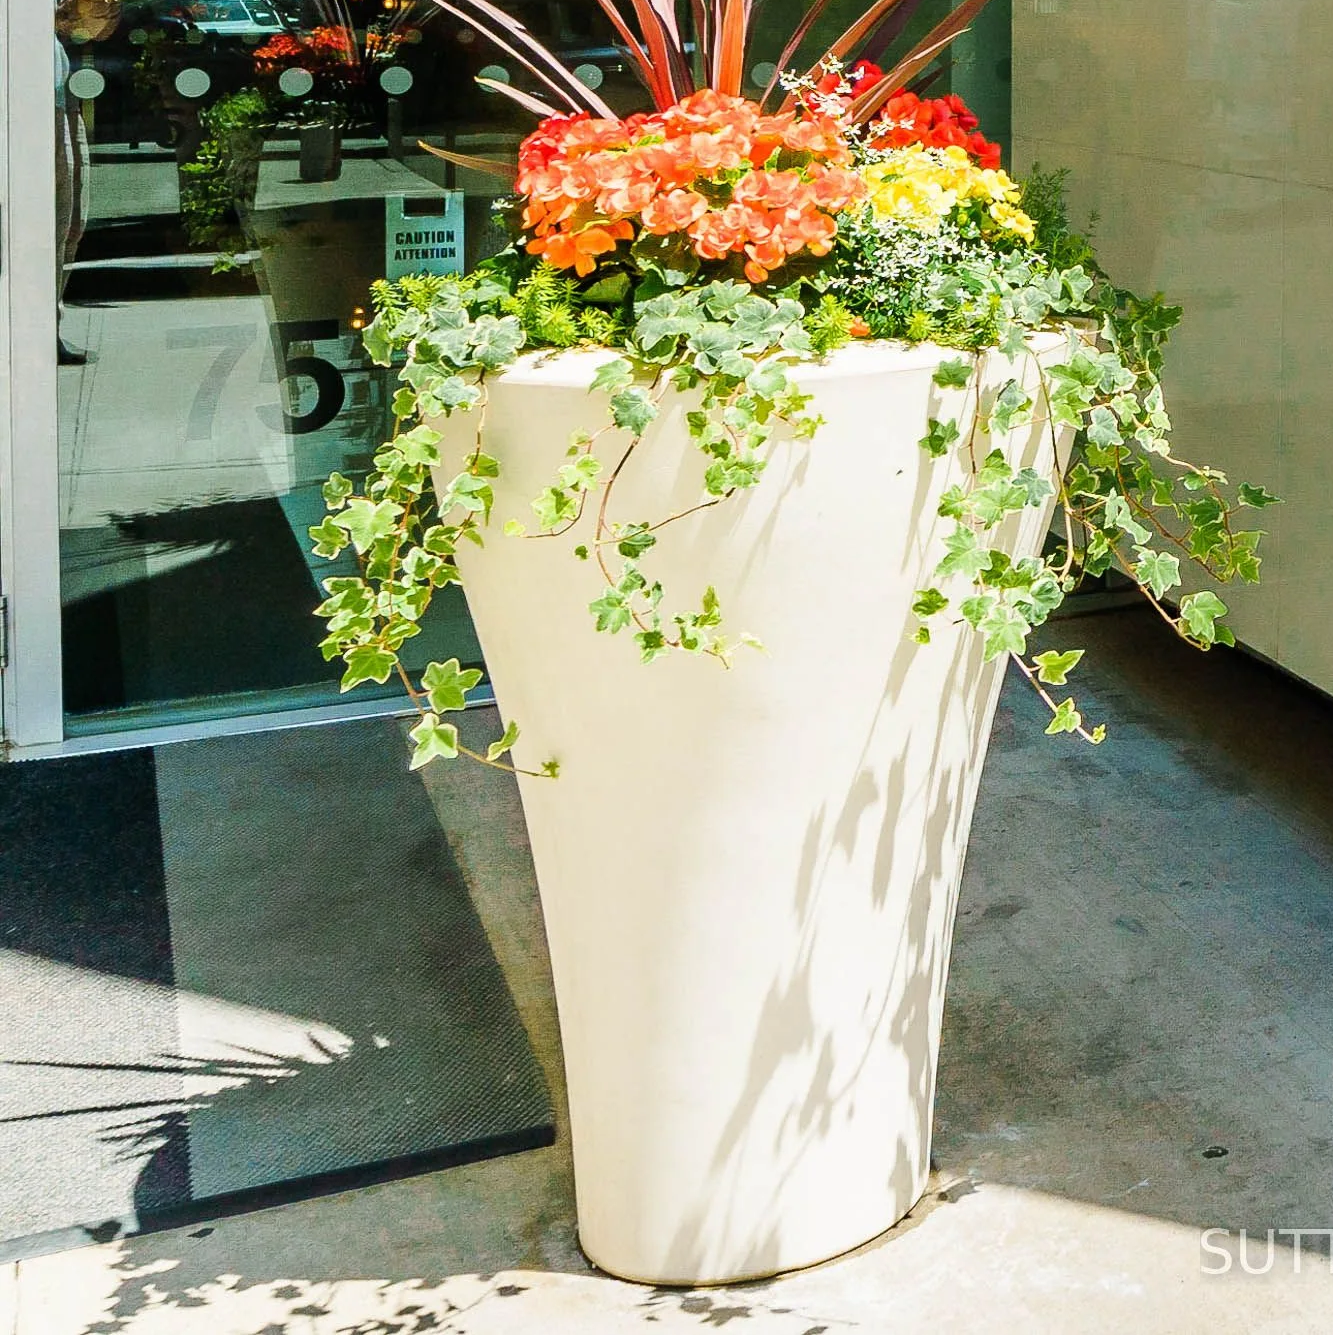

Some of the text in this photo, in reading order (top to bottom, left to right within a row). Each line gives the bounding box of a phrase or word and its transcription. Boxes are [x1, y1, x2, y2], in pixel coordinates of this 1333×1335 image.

[395, 230, 455, 245] CAUTION
[394, 247, 457, 261] ATTENTION
[166, 319, 345, 441] 75
